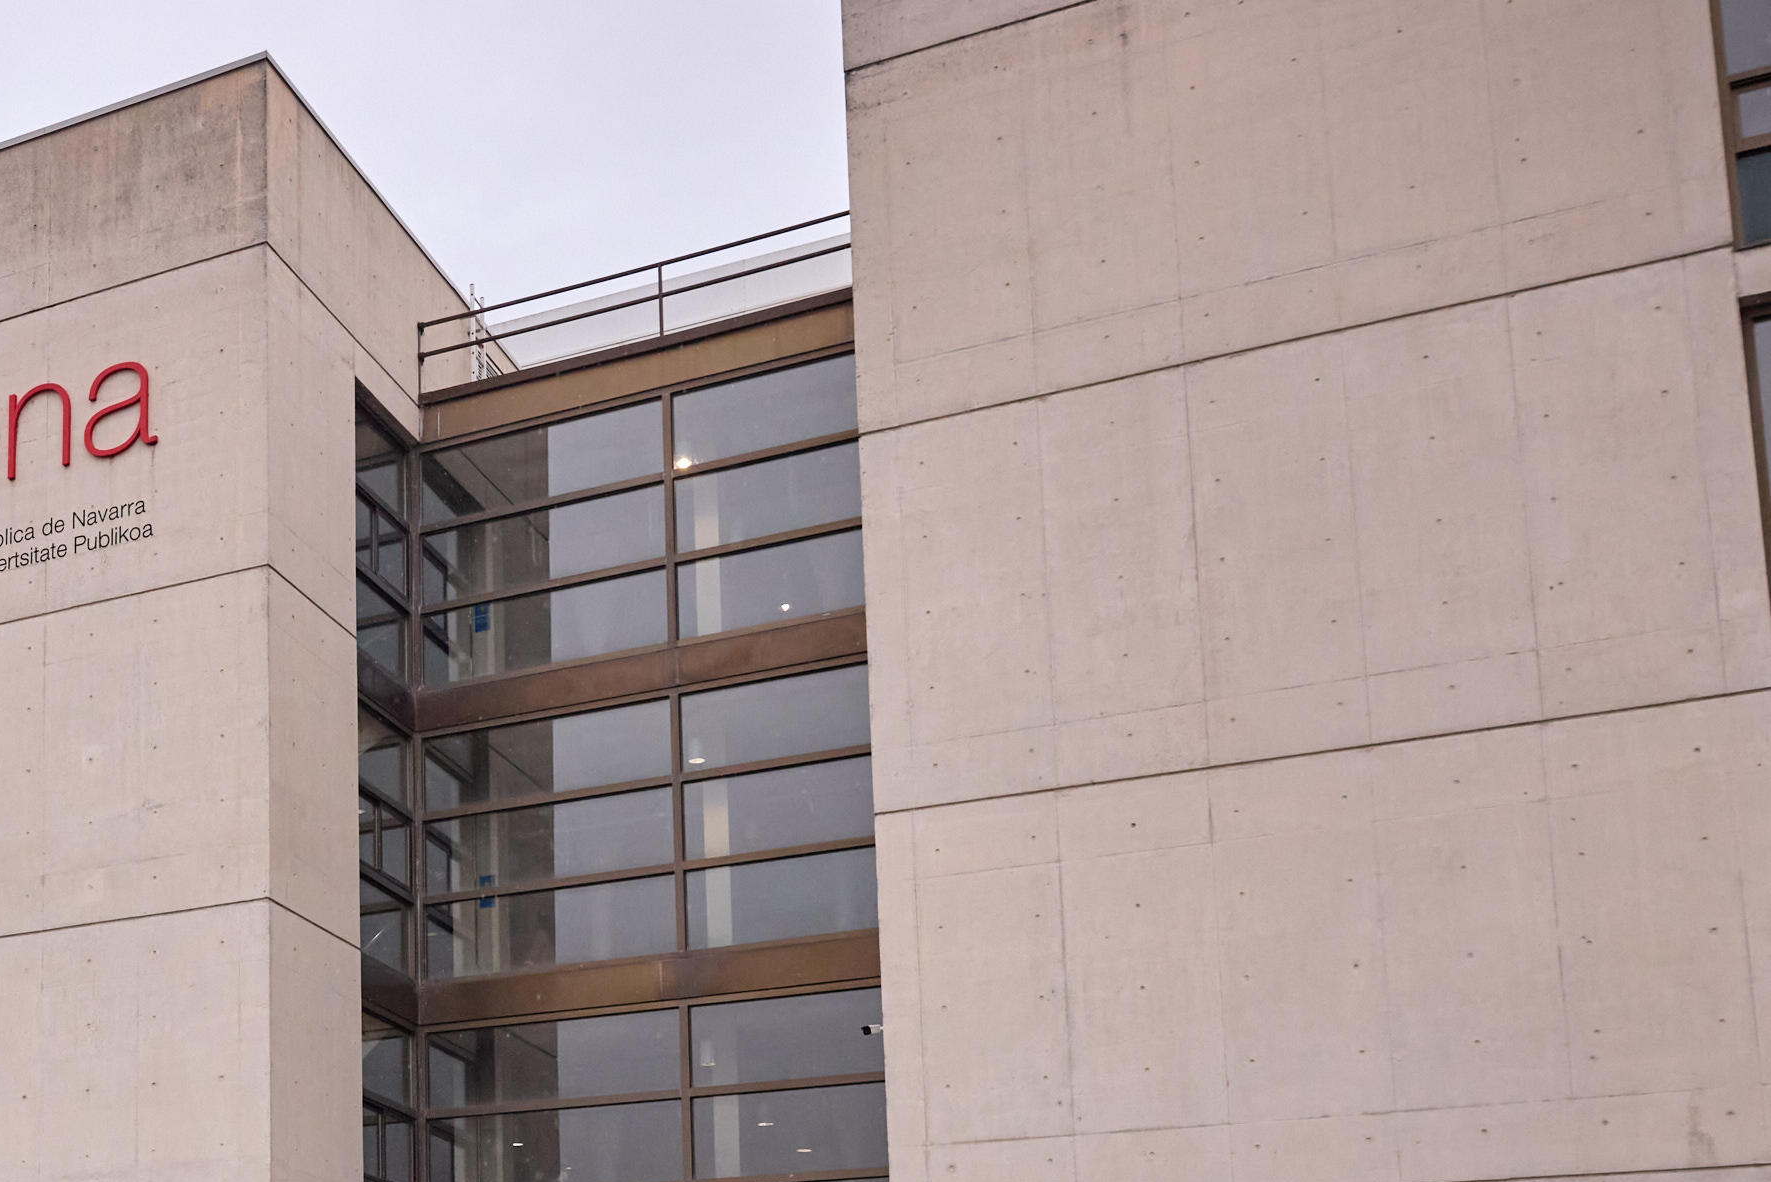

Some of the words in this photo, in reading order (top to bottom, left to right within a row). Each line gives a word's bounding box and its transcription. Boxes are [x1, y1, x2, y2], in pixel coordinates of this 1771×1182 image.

[42, 517, 66, 537] de
[72, 499, 147, 530] Navarra
[74, 522, 154, 555] Publikoa
